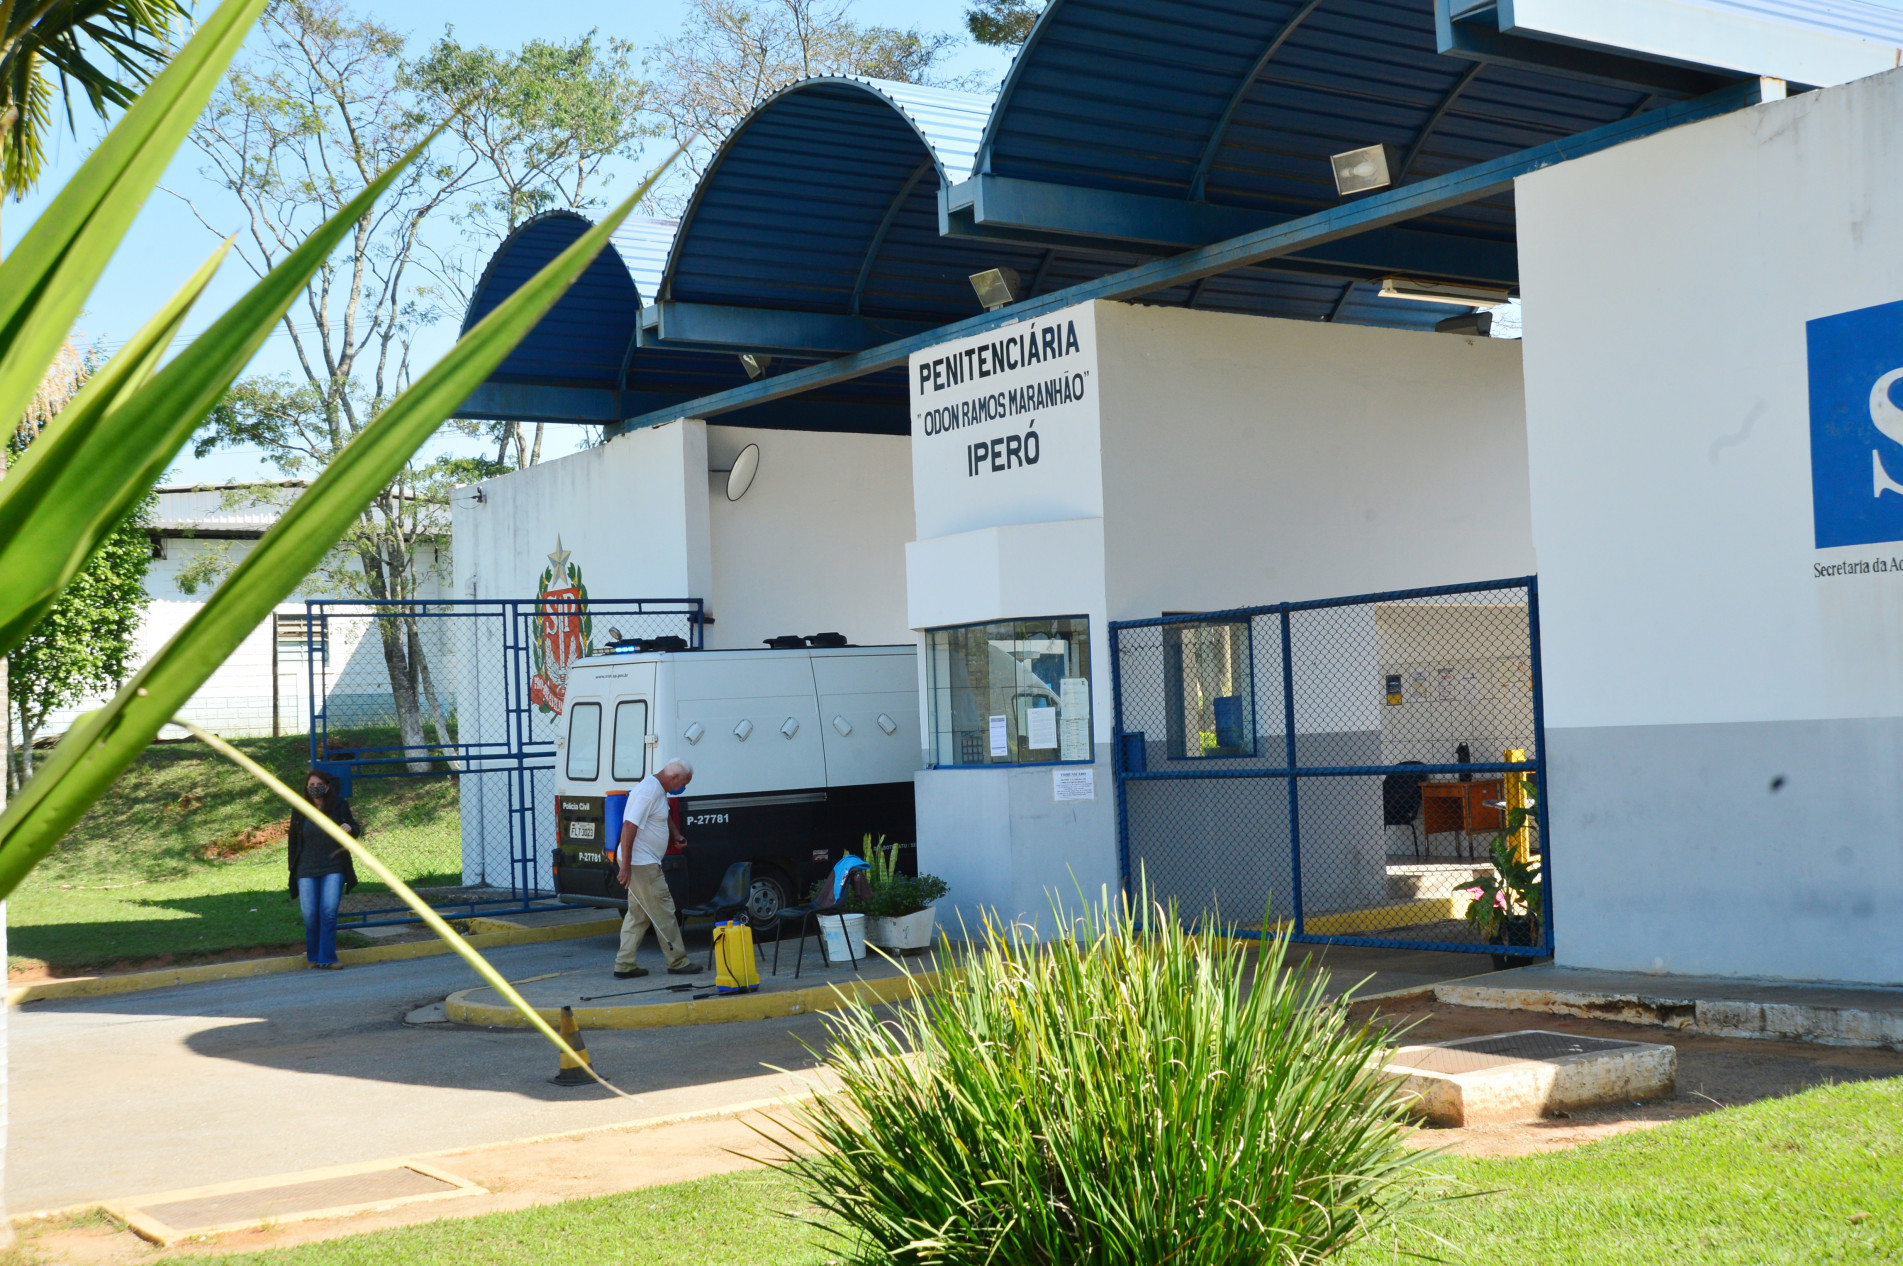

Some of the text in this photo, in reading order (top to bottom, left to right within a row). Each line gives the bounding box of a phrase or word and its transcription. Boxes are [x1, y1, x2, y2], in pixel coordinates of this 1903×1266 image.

[919, 320, 1080, 395] PENITENCIÁRIA
[962, 392, 1006, 428] RAMOS
[967, 419, 1040, 477] IPERÓ
[1813, 560, 1870, 578] Secretaria
[1872, 557, 1887, 573] da
[579, 802, 590, 811] Civil
[686, 813, 729, 826] P-27781
[578, 852, 602, 862] P-27781
